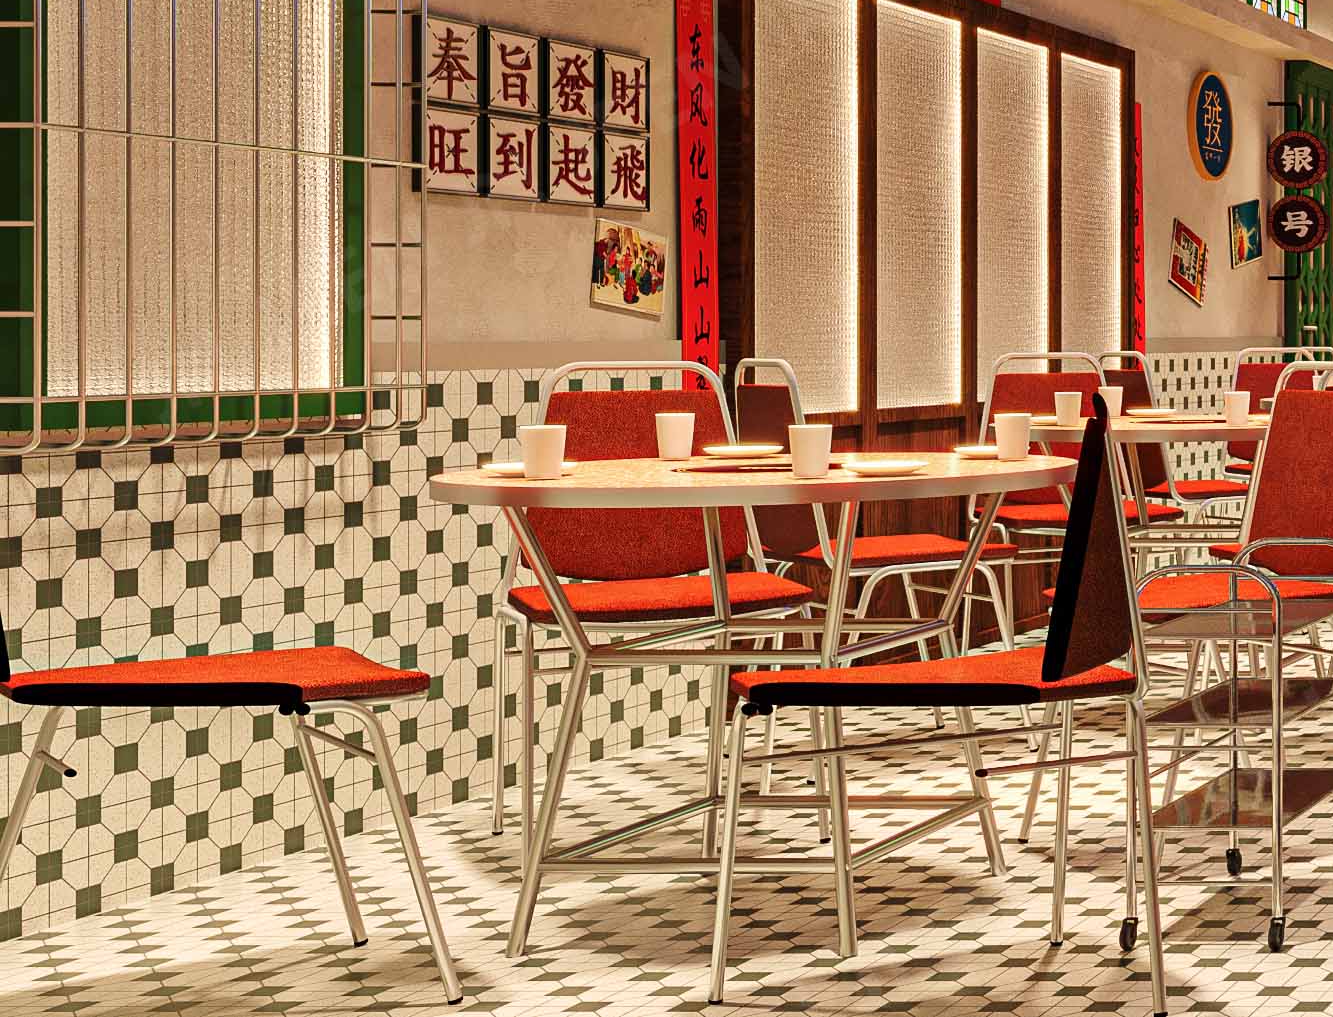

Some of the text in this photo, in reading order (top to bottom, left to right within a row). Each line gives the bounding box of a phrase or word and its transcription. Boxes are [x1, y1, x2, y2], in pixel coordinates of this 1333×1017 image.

[427, 27, 646, 125] 奉旨發財
[427, 124, 648, 202] 旺到起飛
[1281, 145, 1313, 238] 银号
